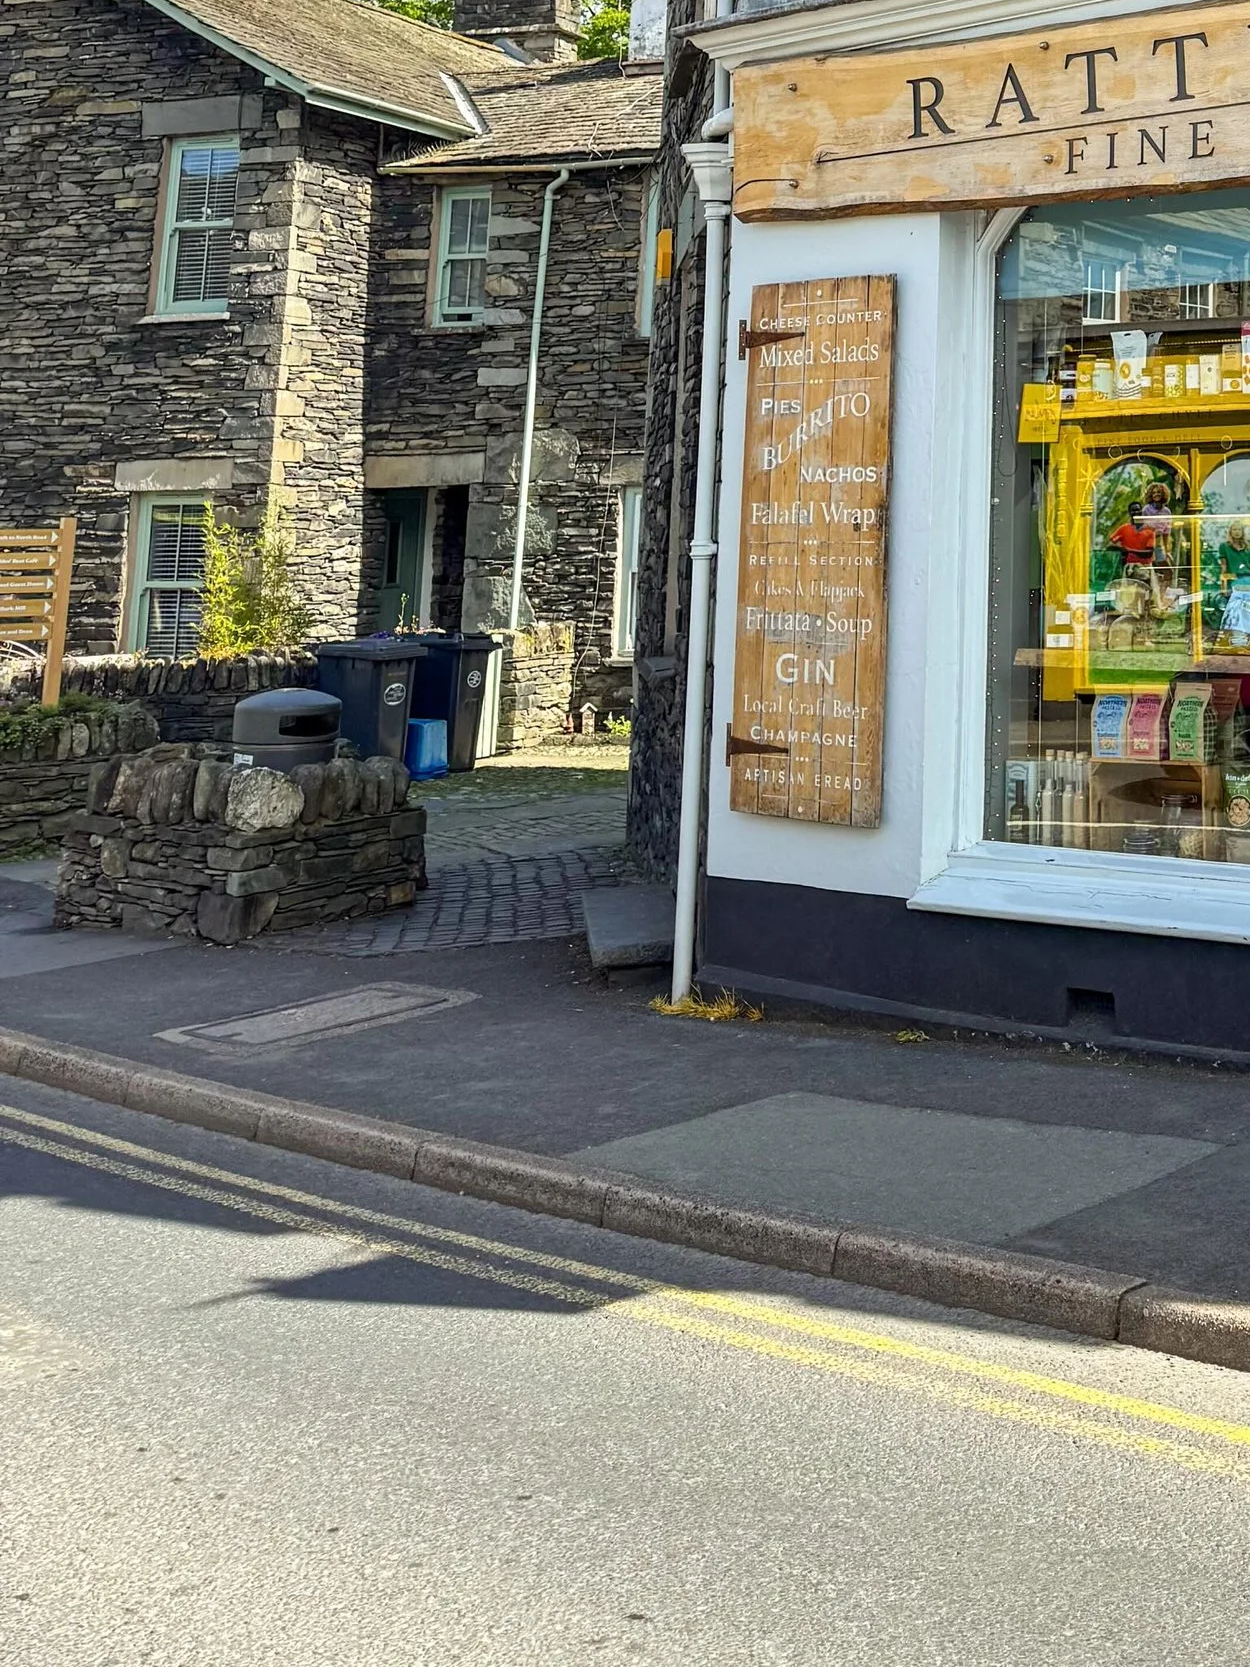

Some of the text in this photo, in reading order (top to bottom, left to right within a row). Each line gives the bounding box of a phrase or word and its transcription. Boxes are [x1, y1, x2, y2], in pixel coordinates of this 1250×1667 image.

[1064, 119, 1217, 176] FINE
[759, 309, 882, 331] CHEESE COUNTER
[759, 336, 880, 369] Mixed Salads
[761, 397, 801, 416] PIES
[762, 391, 871, 471] BURRITO
[800, 466, 878, 484] NACHOS
[750, 501, 876, 532] Falafel Wrap
[749, 554, 874, 567] REFILL SECTION
[810, 579, 866, 604] Flapjack
[746, 606, 873, 641] Frittata Soup
[775, 652, 836, 686] GIN
[743, 694, 868, 720] Local Craft Beer
[750, 725, 858, 748] CHAMPAGNE
[744, 768, 863, 792] ARTISAN BREAD
